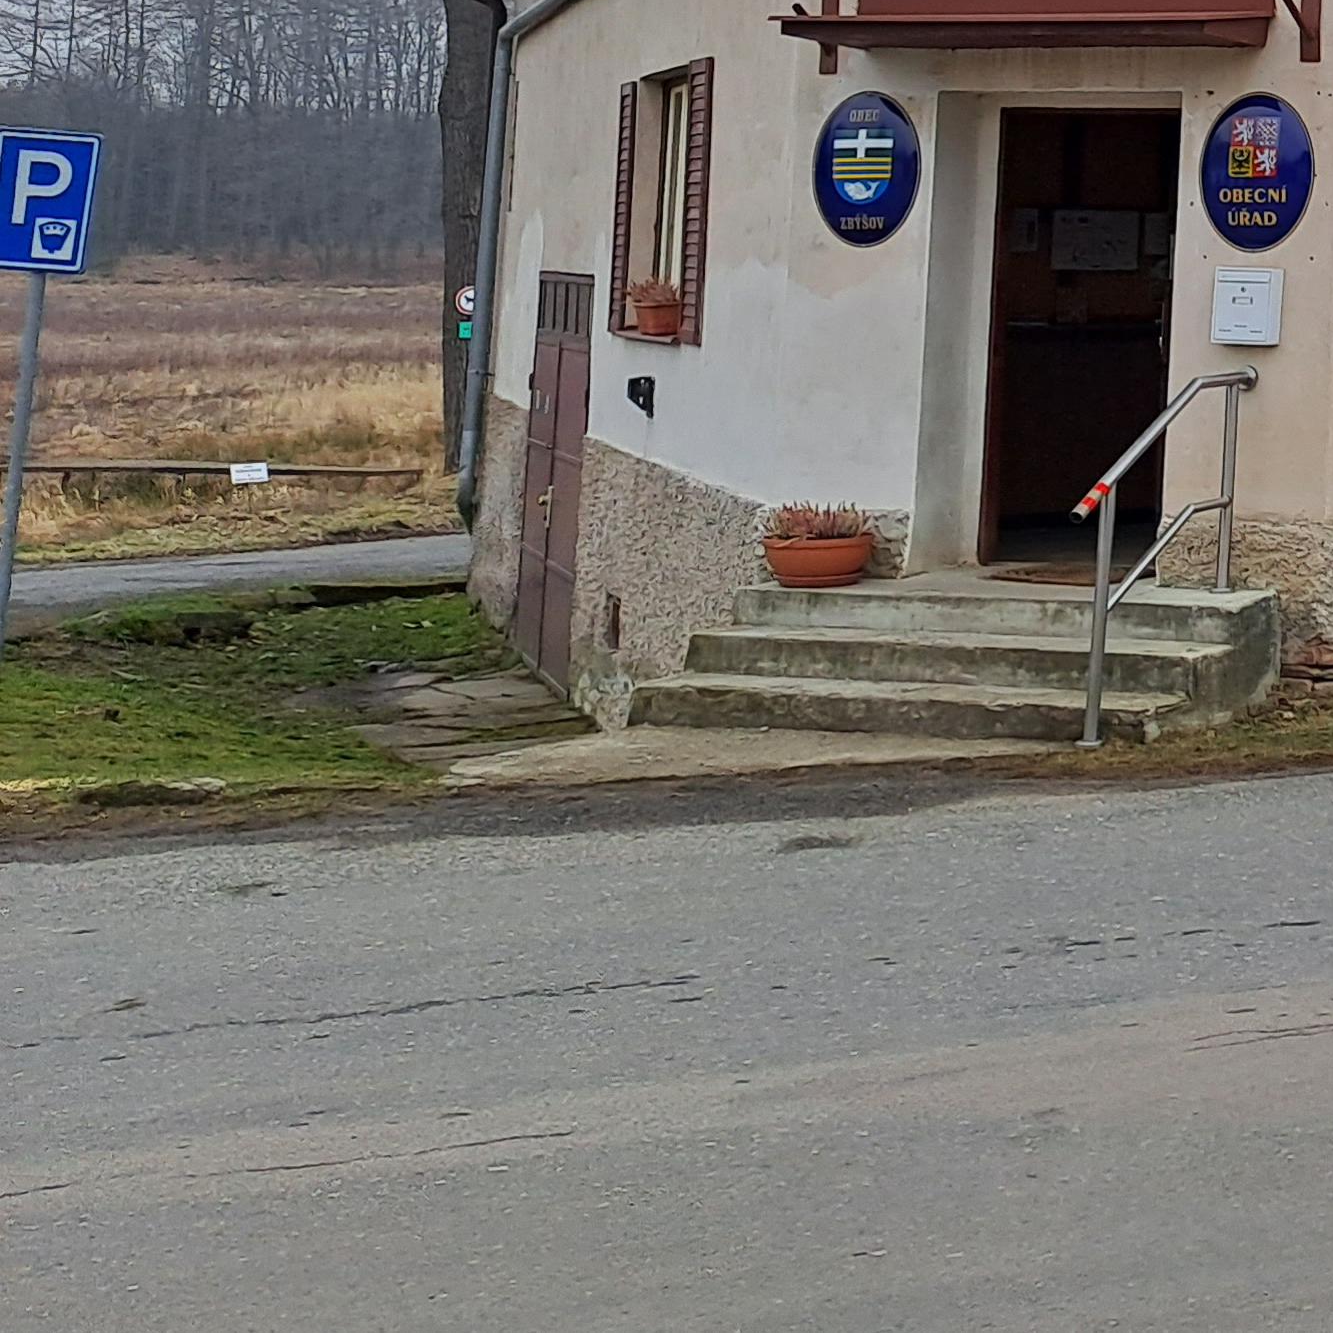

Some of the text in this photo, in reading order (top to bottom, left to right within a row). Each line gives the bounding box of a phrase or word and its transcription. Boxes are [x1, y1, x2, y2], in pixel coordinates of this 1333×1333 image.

[849, 108, 881, 122] OBEC
[11, 149, 73, 224] P
[1219, 184, 1288, 203] OBECNÍ
[840, 213, 885, 230] ZBÝŠOV
[1228, 207, 1278, 226] ÚŘAD
